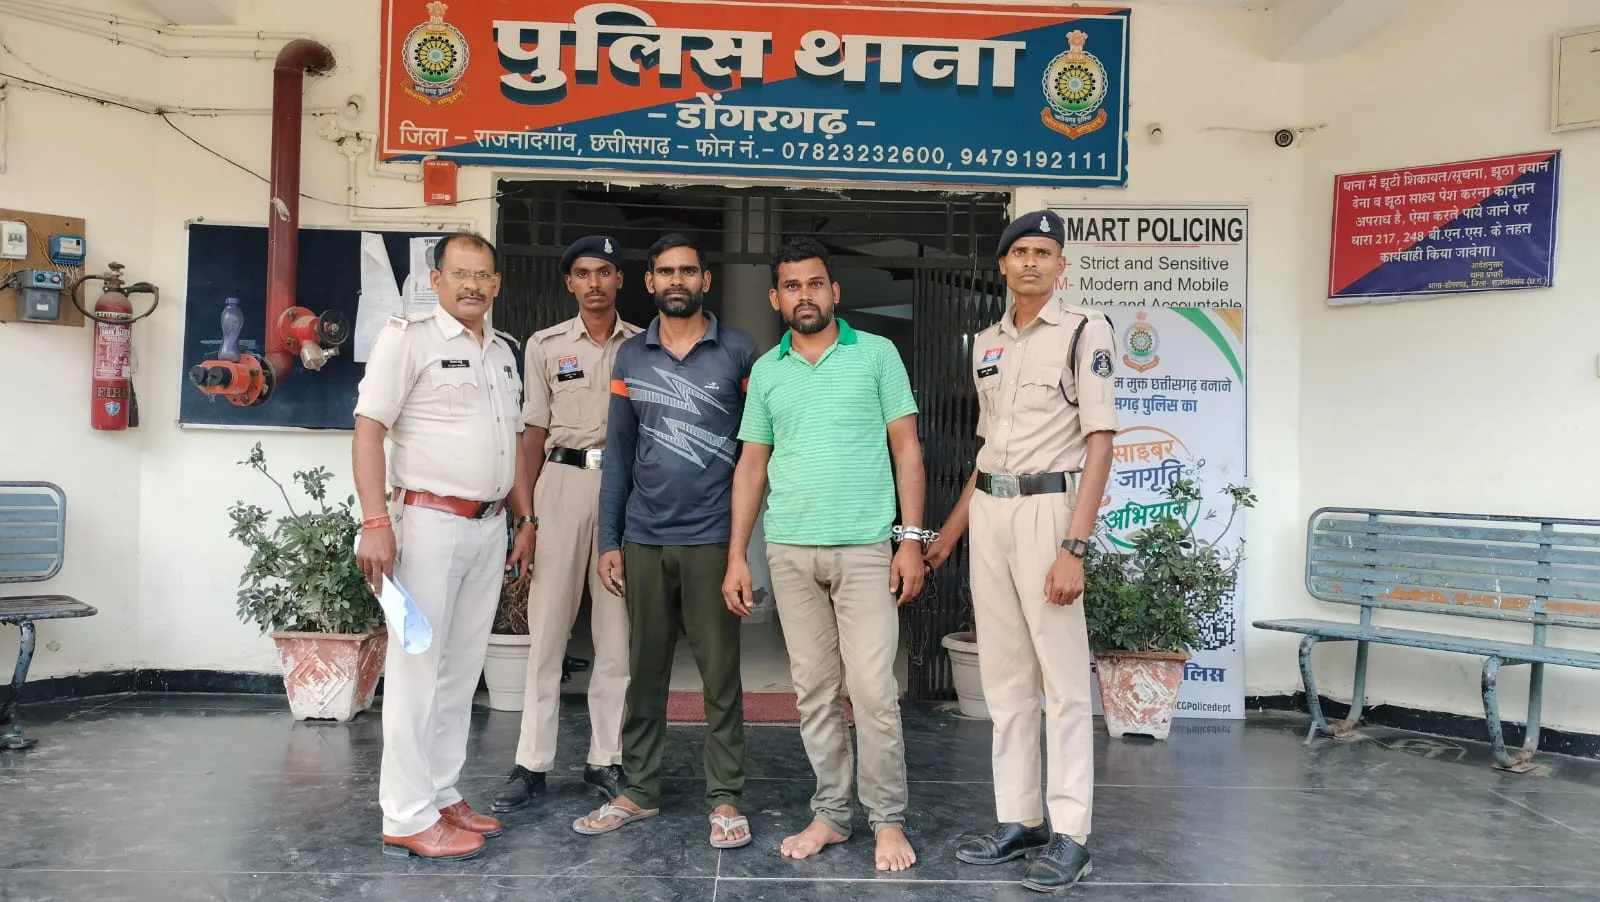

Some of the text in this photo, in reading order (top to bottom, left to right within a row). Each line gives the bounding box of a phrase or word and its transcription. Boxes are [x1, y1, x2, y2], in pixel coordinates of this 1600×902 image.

[493, 3, 1026, 98] पुलिस थाना
[675, 92, 849, 140] डोंगरगढ़
[399, 119, 448, 146] जिला
[474, 125, 582, 156] राजनांदगांव,
[590, 128, 671, 158] छत्तीसगढ़
[696, 133, 735, 158] फोन
[782, 142, 953, 170] 07823232600,
[961, 150, 1107, 170] 9479192111
[1343, 180, 1365, 191] थाना
[1369, 175, 1377, 189] में
[1491, 164, 1515, 180] झूठा
[1518, 161, 1549, 174] बयान
[1352, 182, 1535, 209] देना व झूठा साक्ष्य पेश करना कानूनन
[1356, 214, 1391, 227] अपराध
[1409, 209, 1429, 225] ऐसा
[1433, 205, 1459, 221] करते
[1463, 204, 1483, 219] पाये
[1487, 201, 1510, 216] जाने
[1513, 203, 1529, 215] पर
[1062, 217, 1243, 243] MART POLICING
[1403, 231, 1424, 242] 248
[1490, 221, 1502, 236] के
[1505, 223, 1532, 235] तहत
[1080, 256, 1229, 271] Strict and Sensitive
[1380, 246, 1423, 263] कार्यवाही
[1426, 245, 1452, 260] किया
[1080, 277, 1138, 291] Modern
[1144, 277, 1172, 291] and
[1178, 277, 1229, 292] Mobile
[1127, 377, 1148, 393] मुक्त
[1151, 375, 1198, 394] छत्तीसगढ़
[1200, 377, 1232, 392] बनाने
[1142, 394, 1179, 415] पुलिस
[1181, 400, 1198, 413] का
[1112, 440, 1176, 463] साइबर
[1117, 459, 1185, 492] जागृति
[1183, 662, 1227, 683] लिस
[1175, 701, 1231, 713] CGPolicedept
